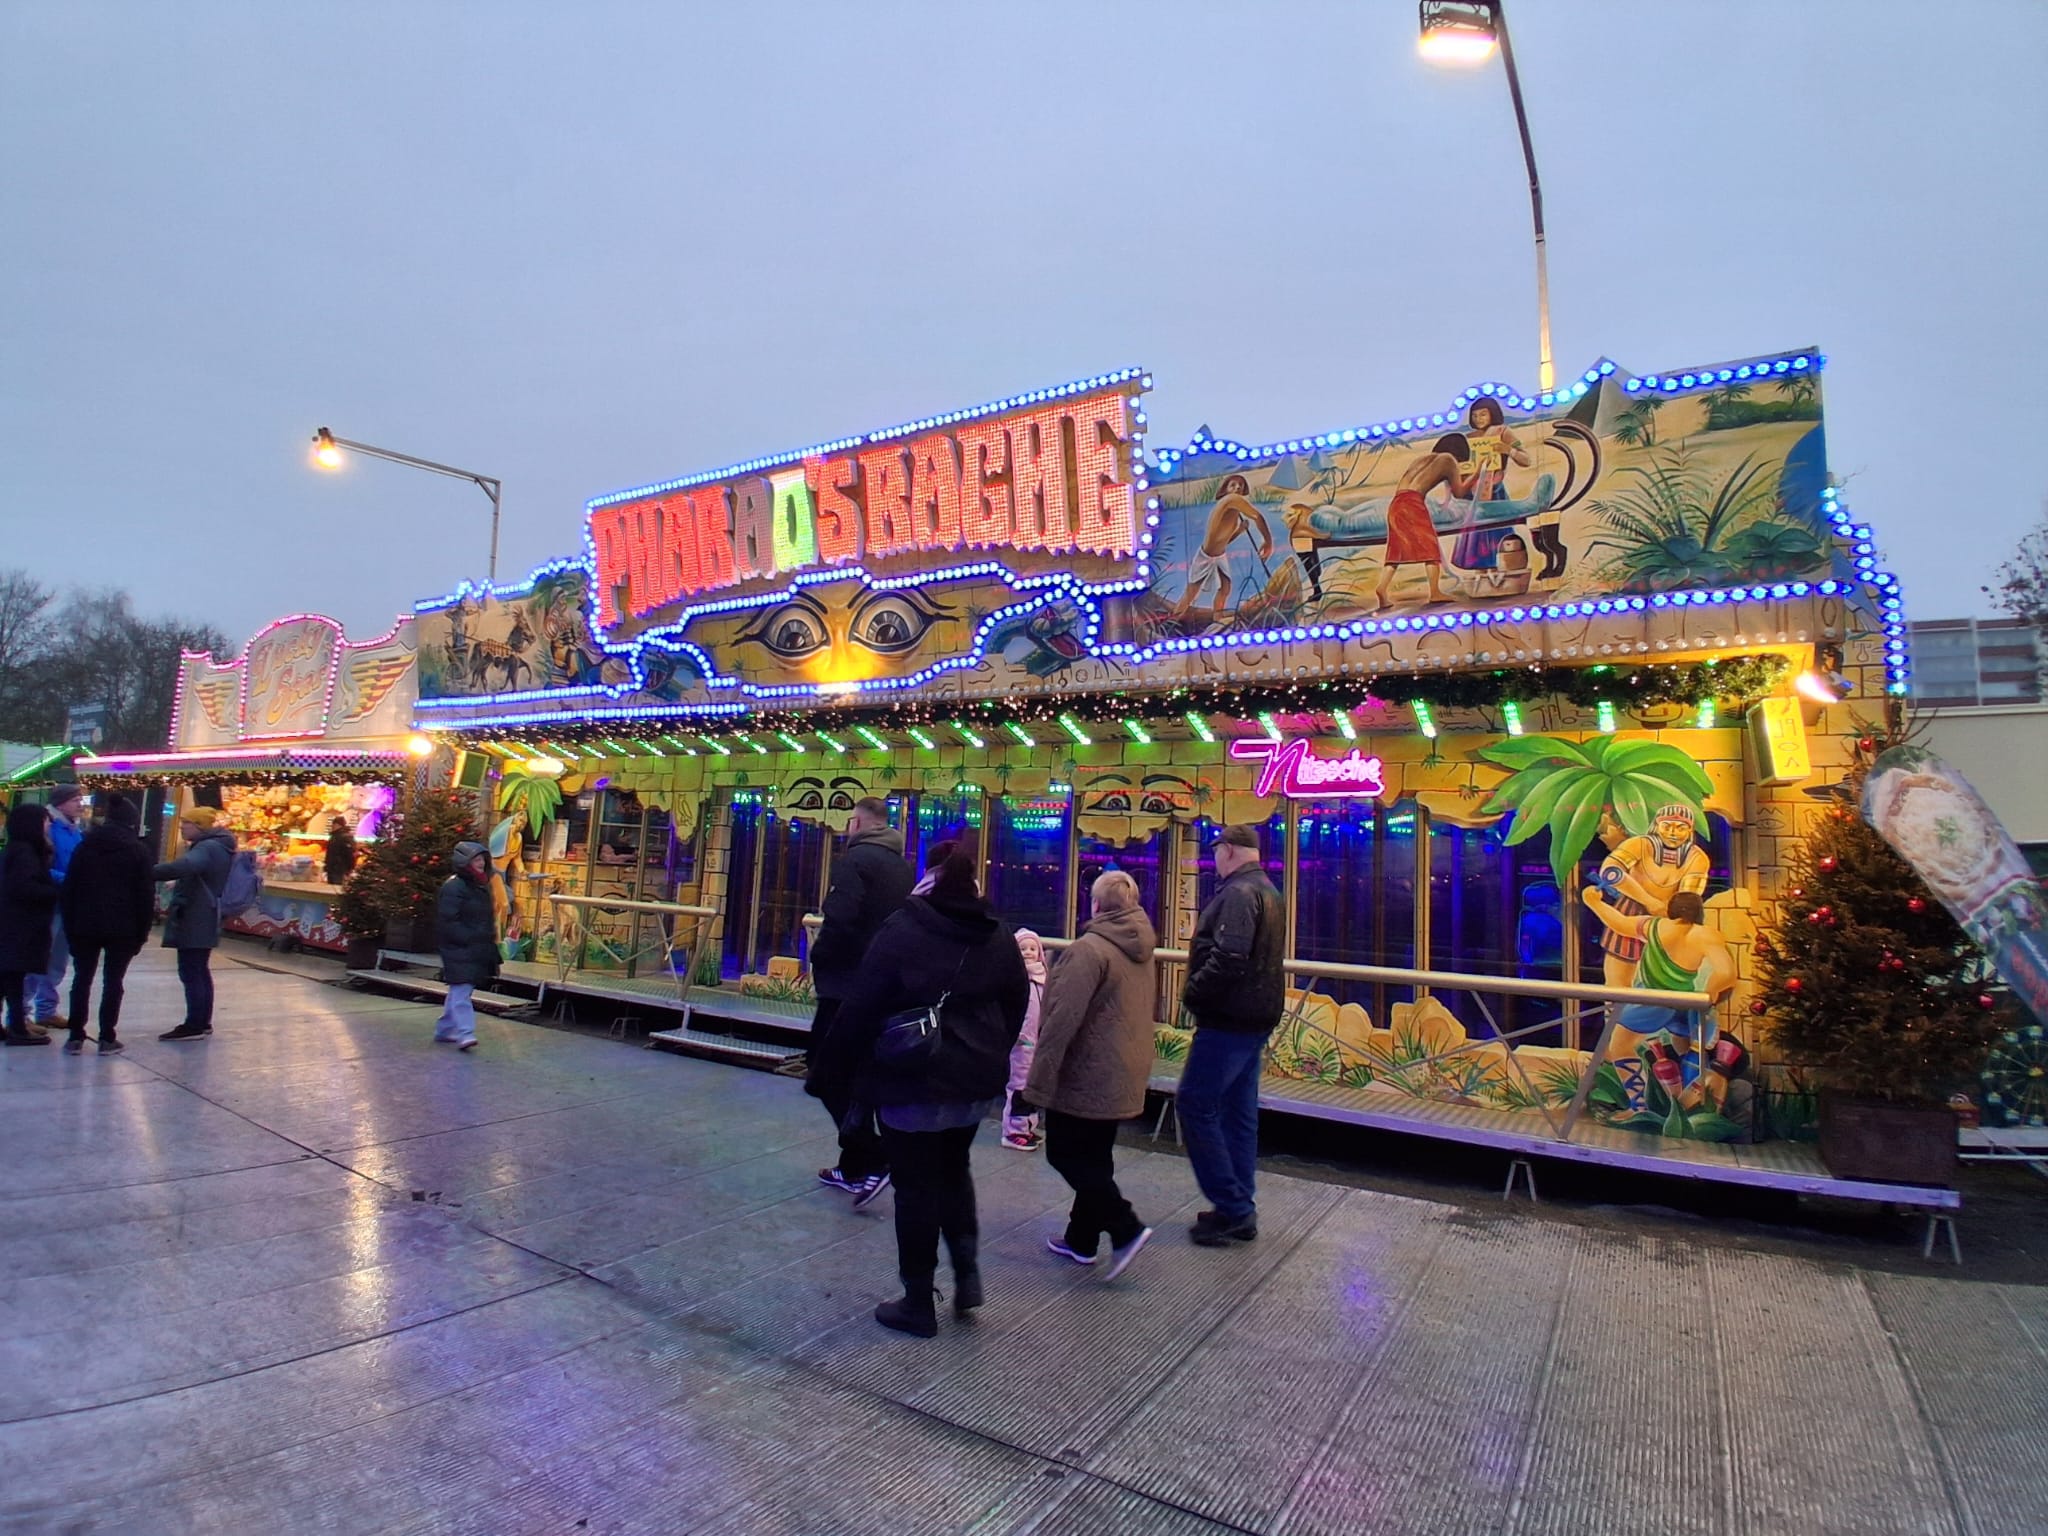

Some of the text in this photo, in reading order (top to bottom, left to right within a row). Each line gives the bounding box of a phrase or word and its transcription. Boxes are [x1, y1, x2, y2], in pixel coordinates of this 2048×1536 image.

[858, 393, 1136, 561] RACHE
[251, 622, 326, 697] Lucky
[267, 663, 328, 724] Star
